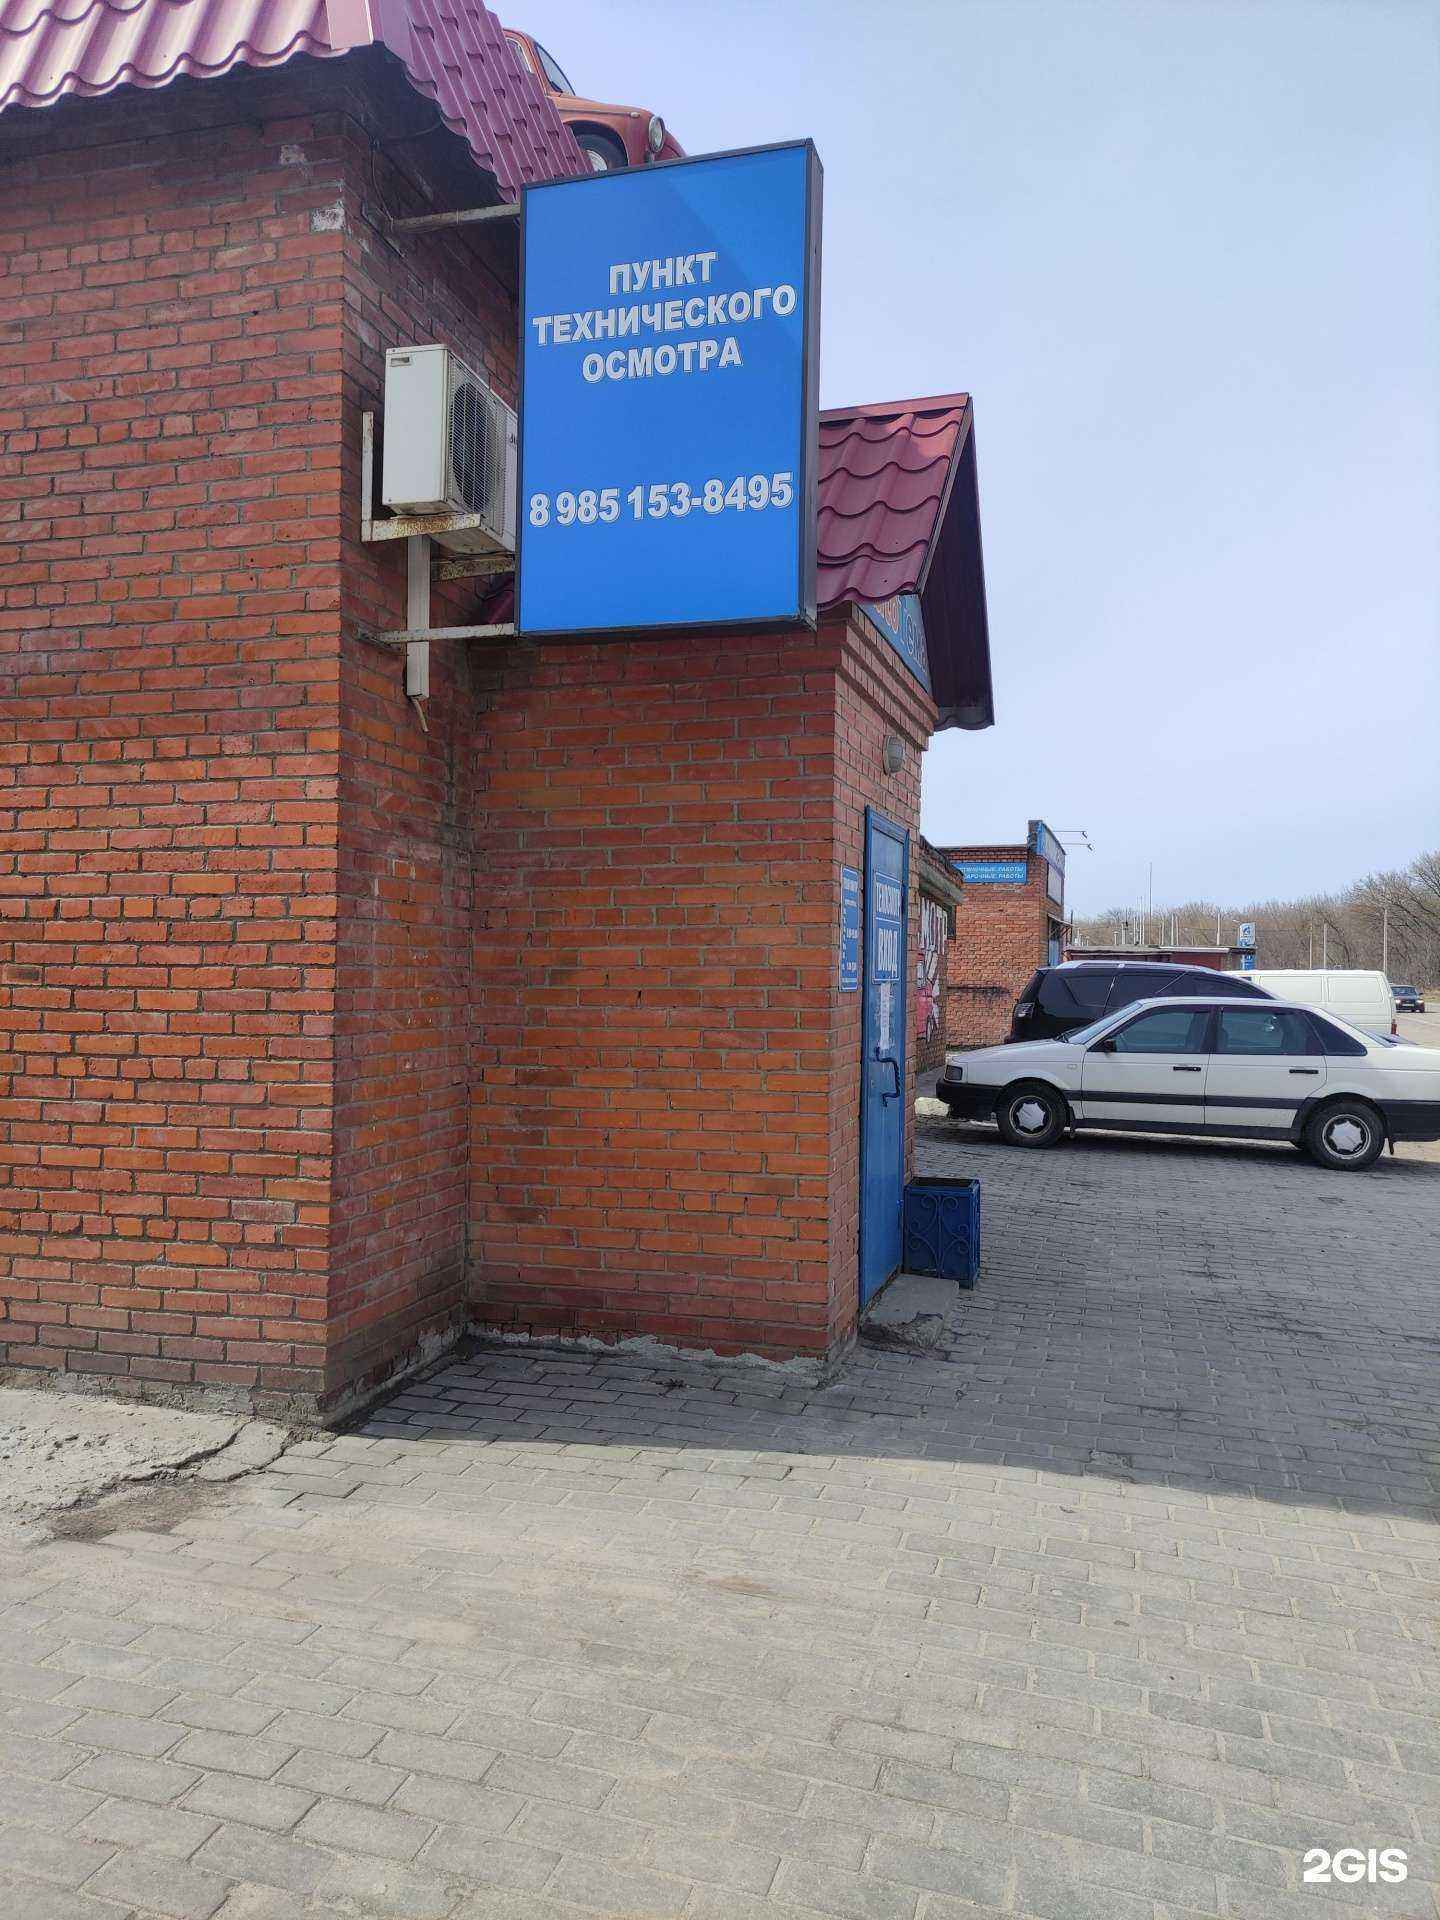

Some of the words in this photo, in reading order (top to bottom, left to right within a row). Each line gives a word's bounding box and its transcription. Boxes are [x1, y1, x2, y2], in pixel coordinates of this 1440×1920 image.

[608, 251, 717, 295] ПУНКТ
[531, 284, 797, 345] ТЕХНИЧЕСКОГО
[581, 337, 743, 383] ОСМОТРА
[529, 493, 551, 527] 8
[555, 488, 620, 526] 985
[626, 472, 793, 521] 153-8495
[878, 928, 898, 978] ВХОД
